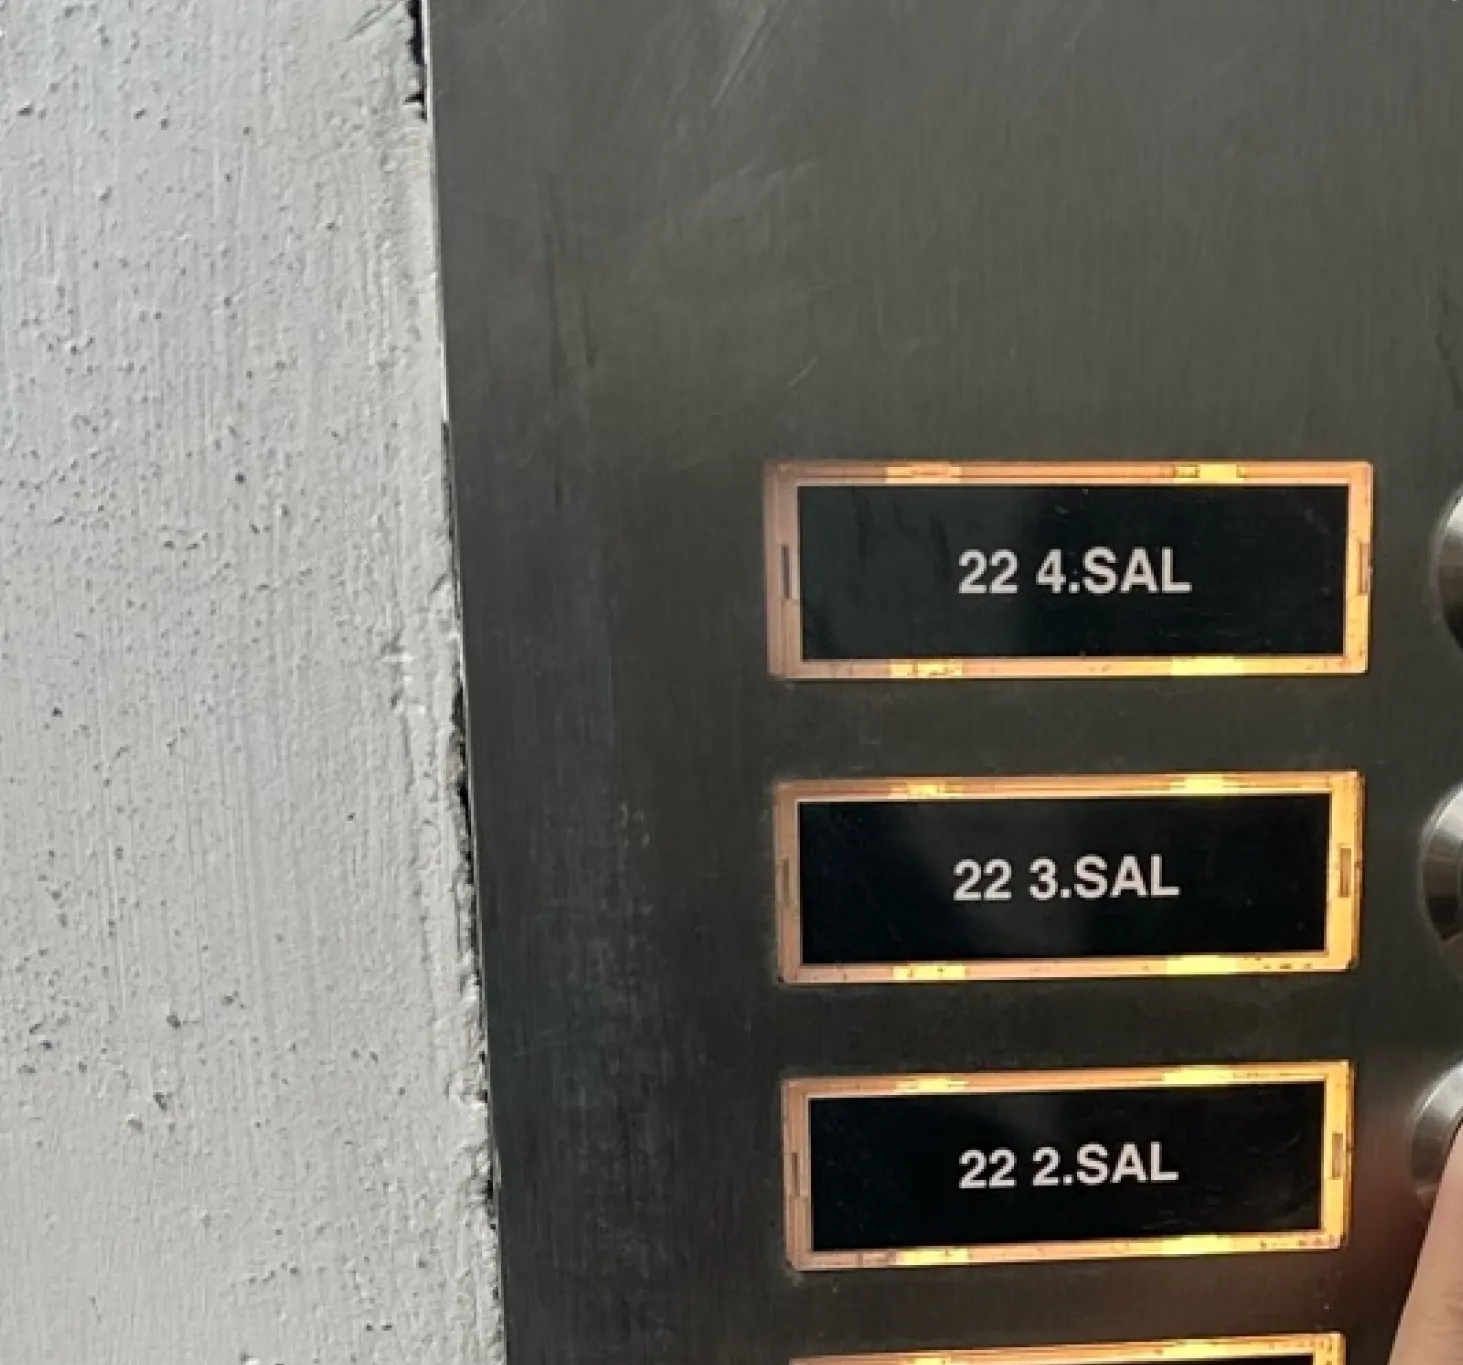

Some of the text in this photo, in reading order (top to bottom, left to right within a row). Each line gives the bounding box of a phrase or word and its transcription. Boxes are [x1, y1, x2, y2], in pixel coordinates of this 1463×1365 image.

[958, 547, 1191, 594] 22 4.SAL
[953, 855, 1180, 901] 22 3.SAL
[958, 1141, 1179, 1189] 22 2.SAL
